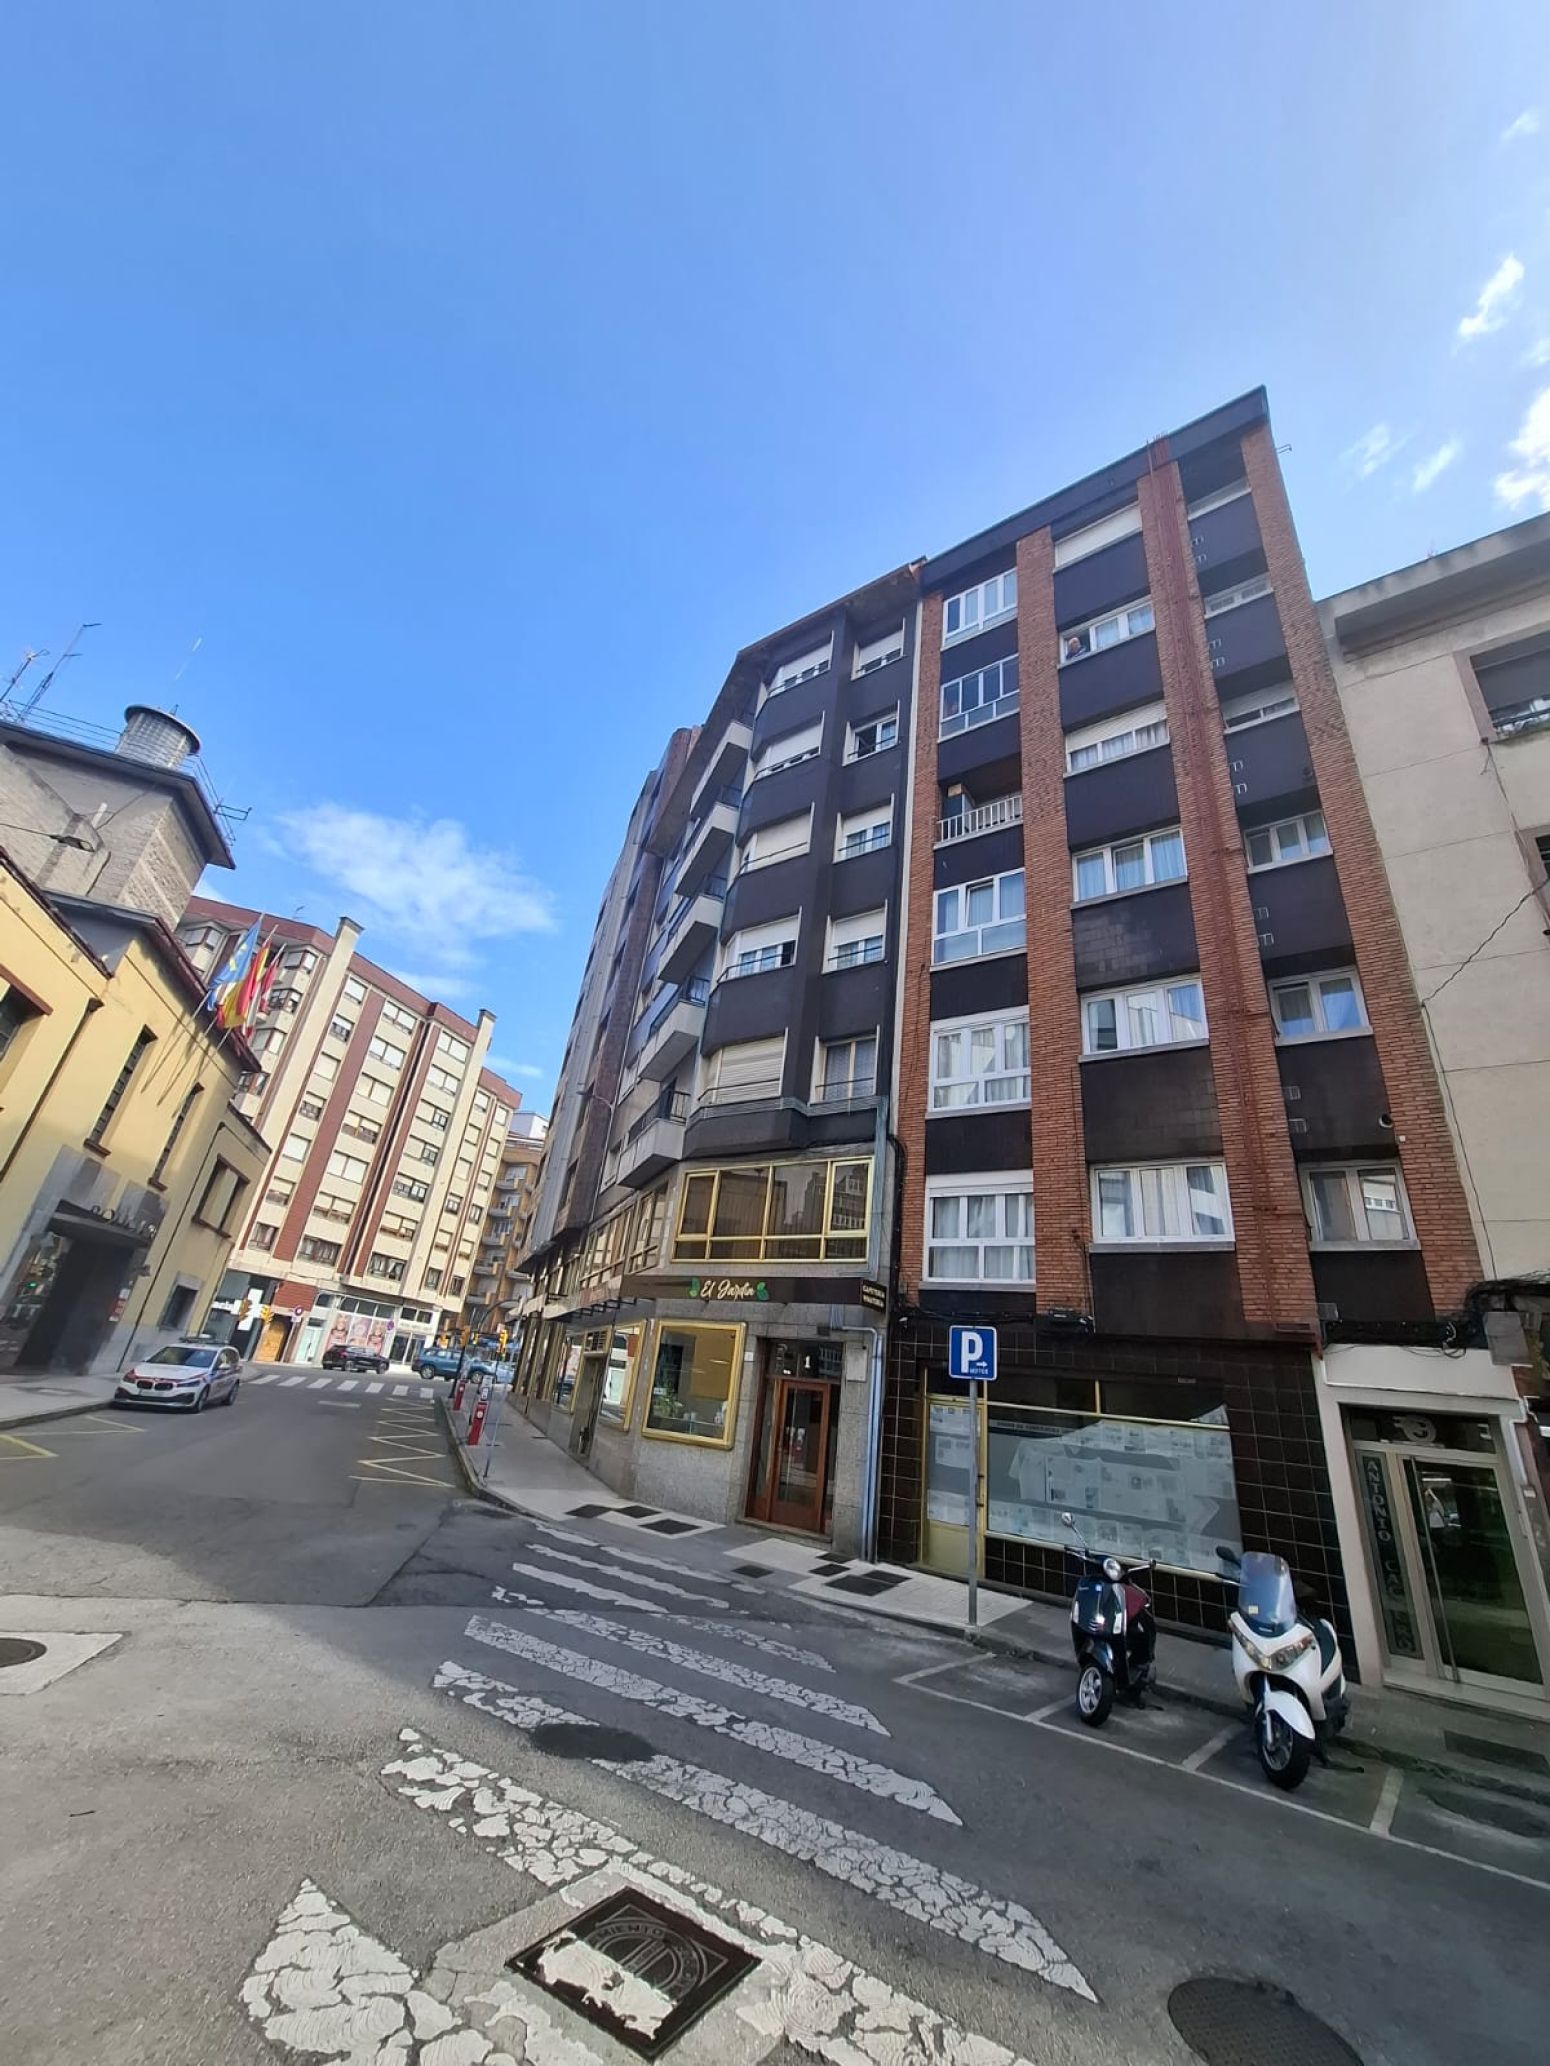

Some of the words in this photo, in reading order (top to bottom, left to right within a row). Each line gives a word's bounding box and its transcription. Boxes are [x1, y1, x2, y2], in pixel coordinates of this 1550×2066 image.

[700, 1280, 716, 1298] El
[961, 1331, 983, 1373] P
[1367, 1461, 1392, 1542] ANTONIO
